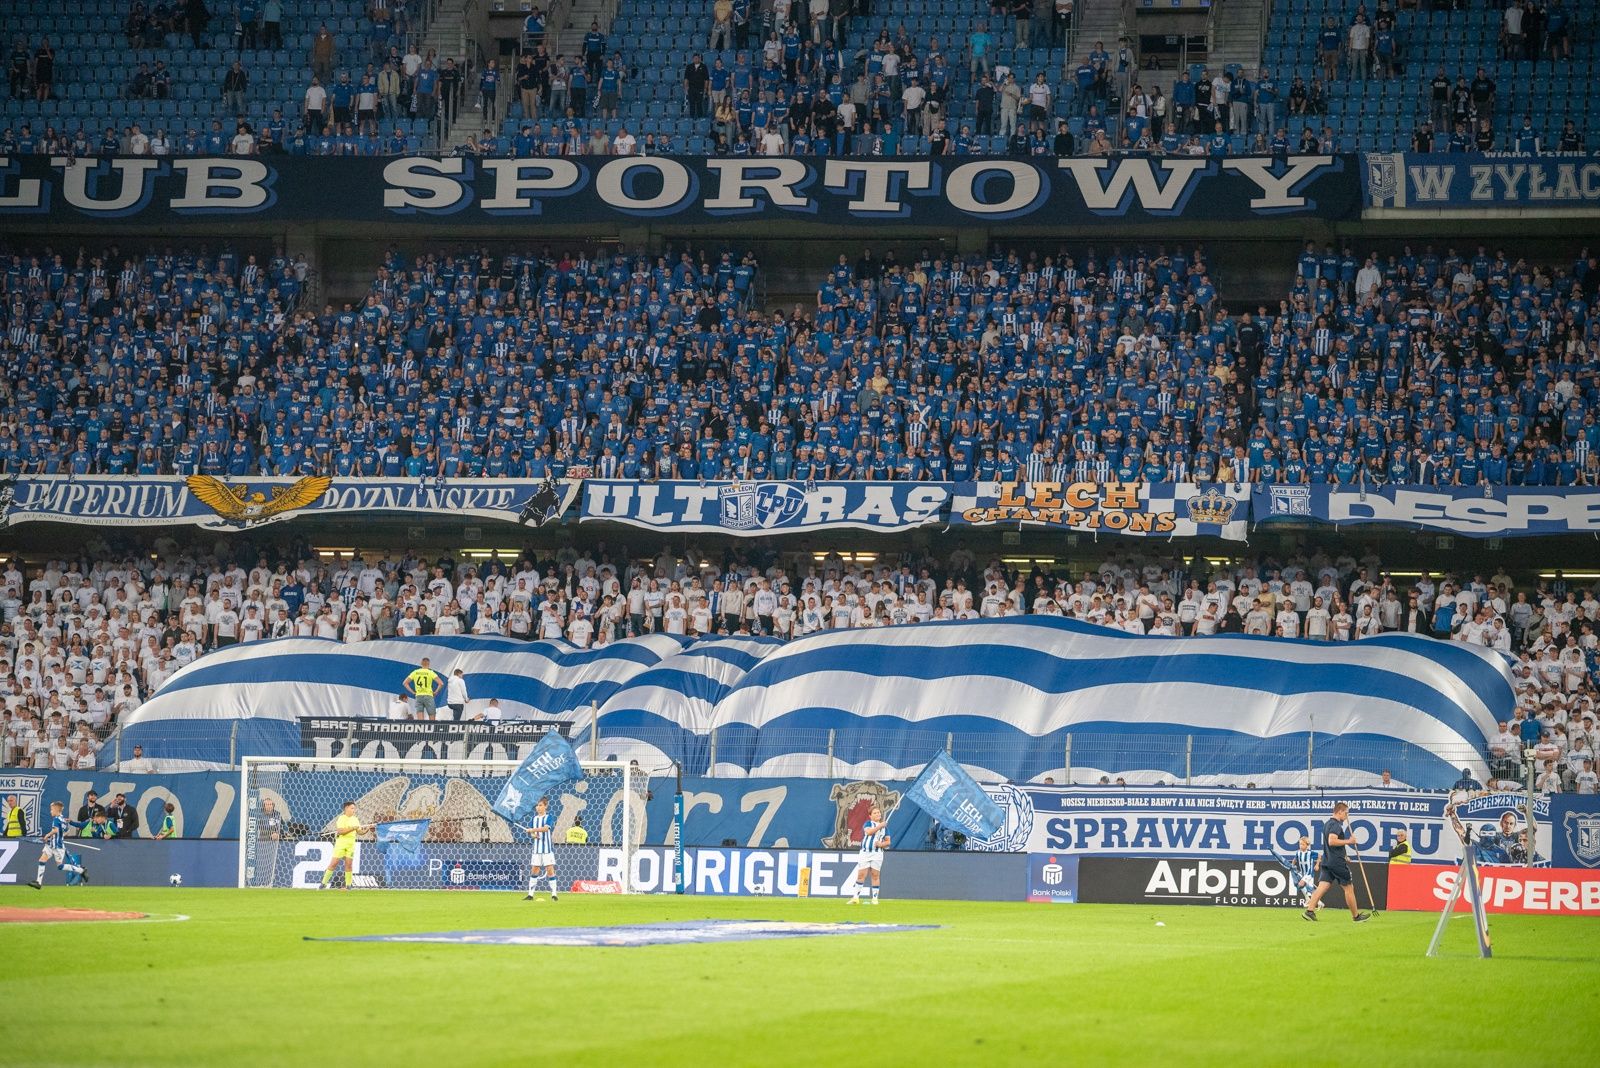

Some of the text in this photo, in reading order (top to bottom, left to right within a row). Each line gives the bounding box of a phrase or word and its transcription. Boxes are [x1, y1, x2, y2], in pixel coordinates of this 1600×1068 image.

[383, 155, 1333, 211] SPORTOWY
[1409, 165, 1455, 201] W
[24, 483, 190, 517] IMPERIUM
[756, 491, 802, 516] LPU
[997, 481, 1143, 510] LECH
[1275, 488, 1306, 496] KKS LECH
[962, 507, 1176, 532] CHAMPIONS
[416, 676, 428, 688] 41
[362, 722, 435, 733] STADIONU
[20, 779, 39, 788] LECH
[960, 798, 983, 823] LECH
[1061, 797, 1086, 807] NOSISZ
[1150, 797, 1177, 808] BARWY
[1178, 798, 1184, 808] A
[1185, 798, 1196, 808] NA
[1197, 798, 1215, 808] NICH
[1246, 799, 1266, 809] HERB
[1362, 799, 1386, 810] TERAZ
[1386, 801, 1397, 810] TY
[1399, 801, 1409, 811] TO
[1410, 801, 1430, 812] LECH
[1468, 793, 1549, 816] REPREZENTUESZ
[1046, 817, 1230, 850] SPRAWA
[600, 850, 871, 896] RODRIGUEZ
[1051, 889, 1071, 897] Polski
[1215, 896, 1257, 905] FLOOR
[1433, 870, 1600, 911] SUPERB
